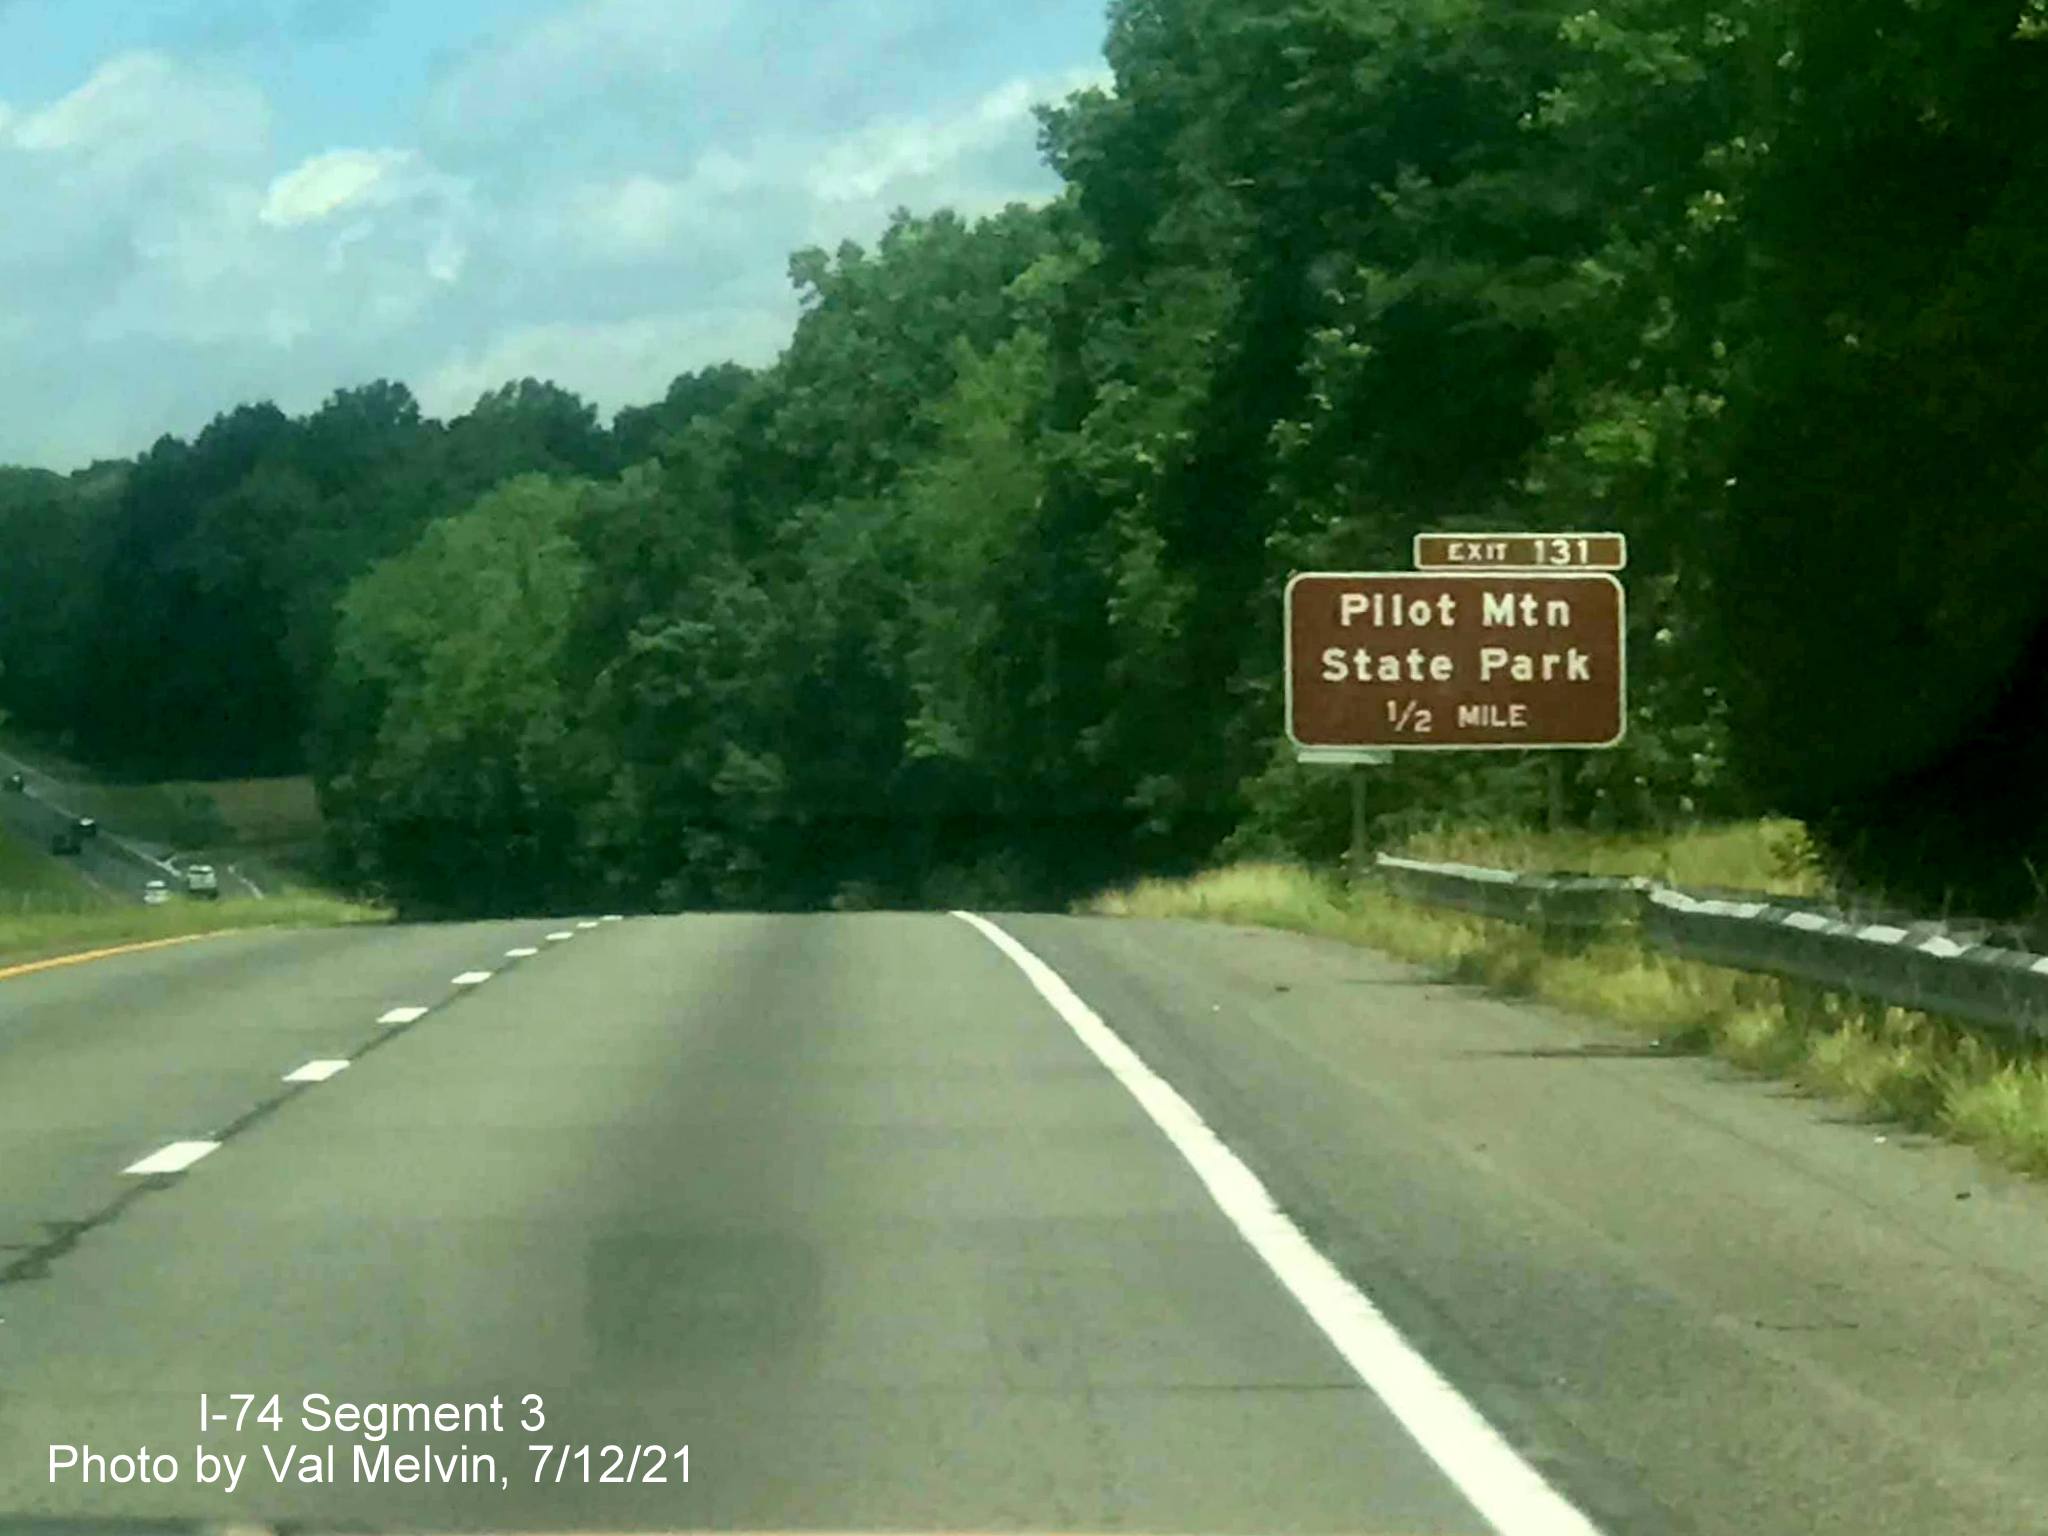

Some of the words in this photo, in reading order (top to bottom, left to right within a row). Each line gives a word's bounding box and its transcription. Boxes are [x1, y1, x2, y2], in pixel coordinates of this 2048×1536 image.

[1447, 543, 1508, 561] EXIT
[1533, 540, 1589, 564] 131
[1340, 592, 1456, 627] Pilot
[1481, 592, 1571, 627] Mtn
[1321, 648, 1454, 682] State
[1479, 648, 1591, 682] Park
[1458, 704, 1528, 728] MILE
